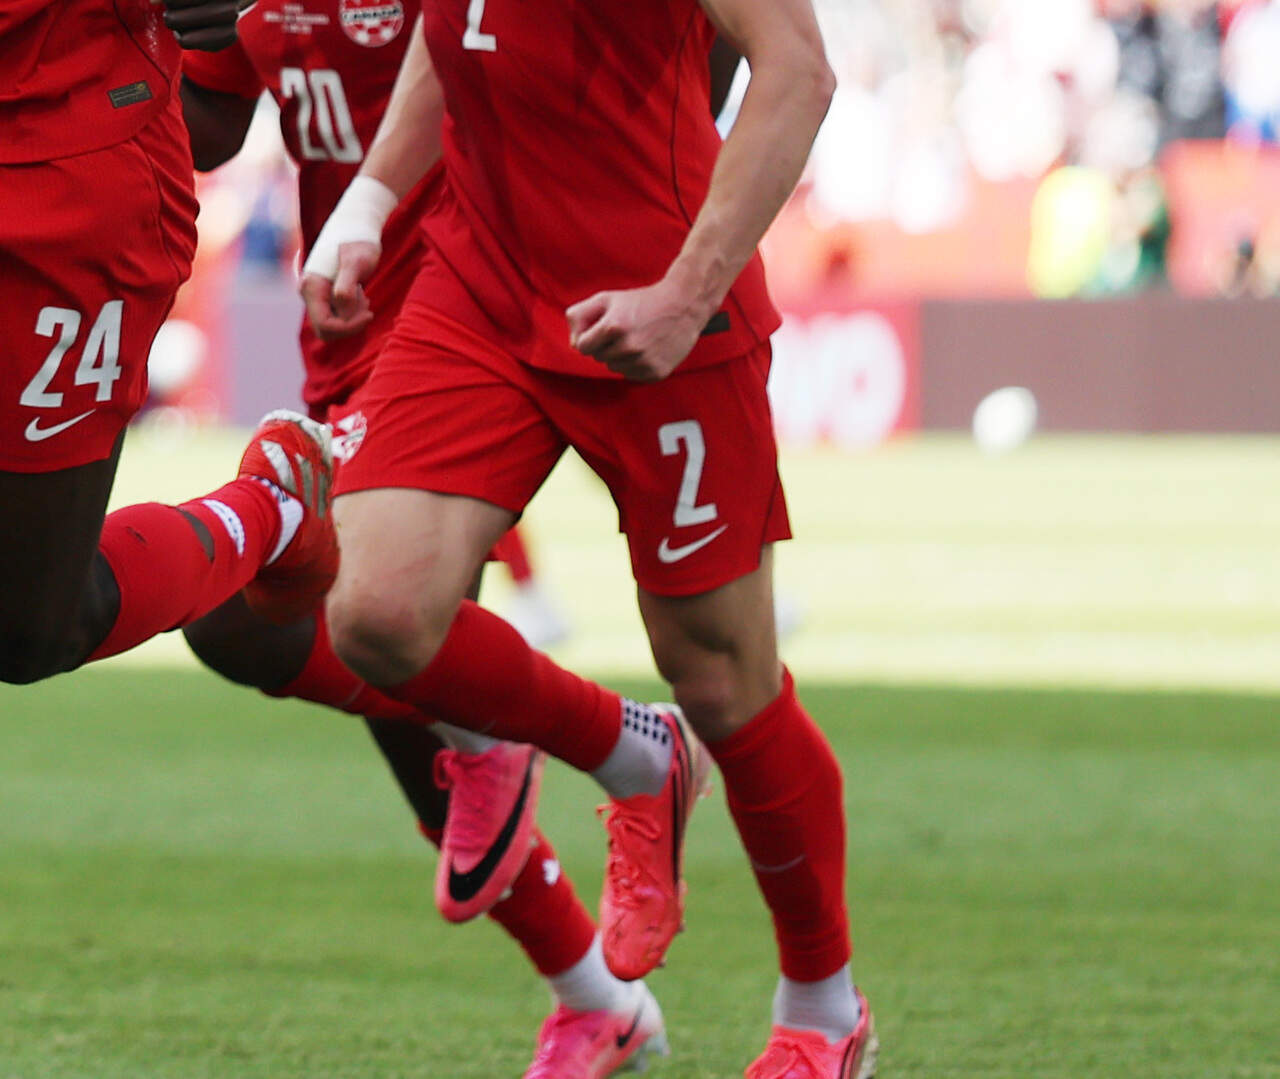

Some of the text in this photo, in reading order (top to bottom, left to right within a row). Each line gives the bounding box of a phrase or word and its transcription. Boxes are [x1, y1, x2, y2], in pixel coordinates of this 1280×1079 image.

[281, 68, 364, 163] 20
[19, 300, 124, 408] 24
[658, 420, 718, 528] 2
